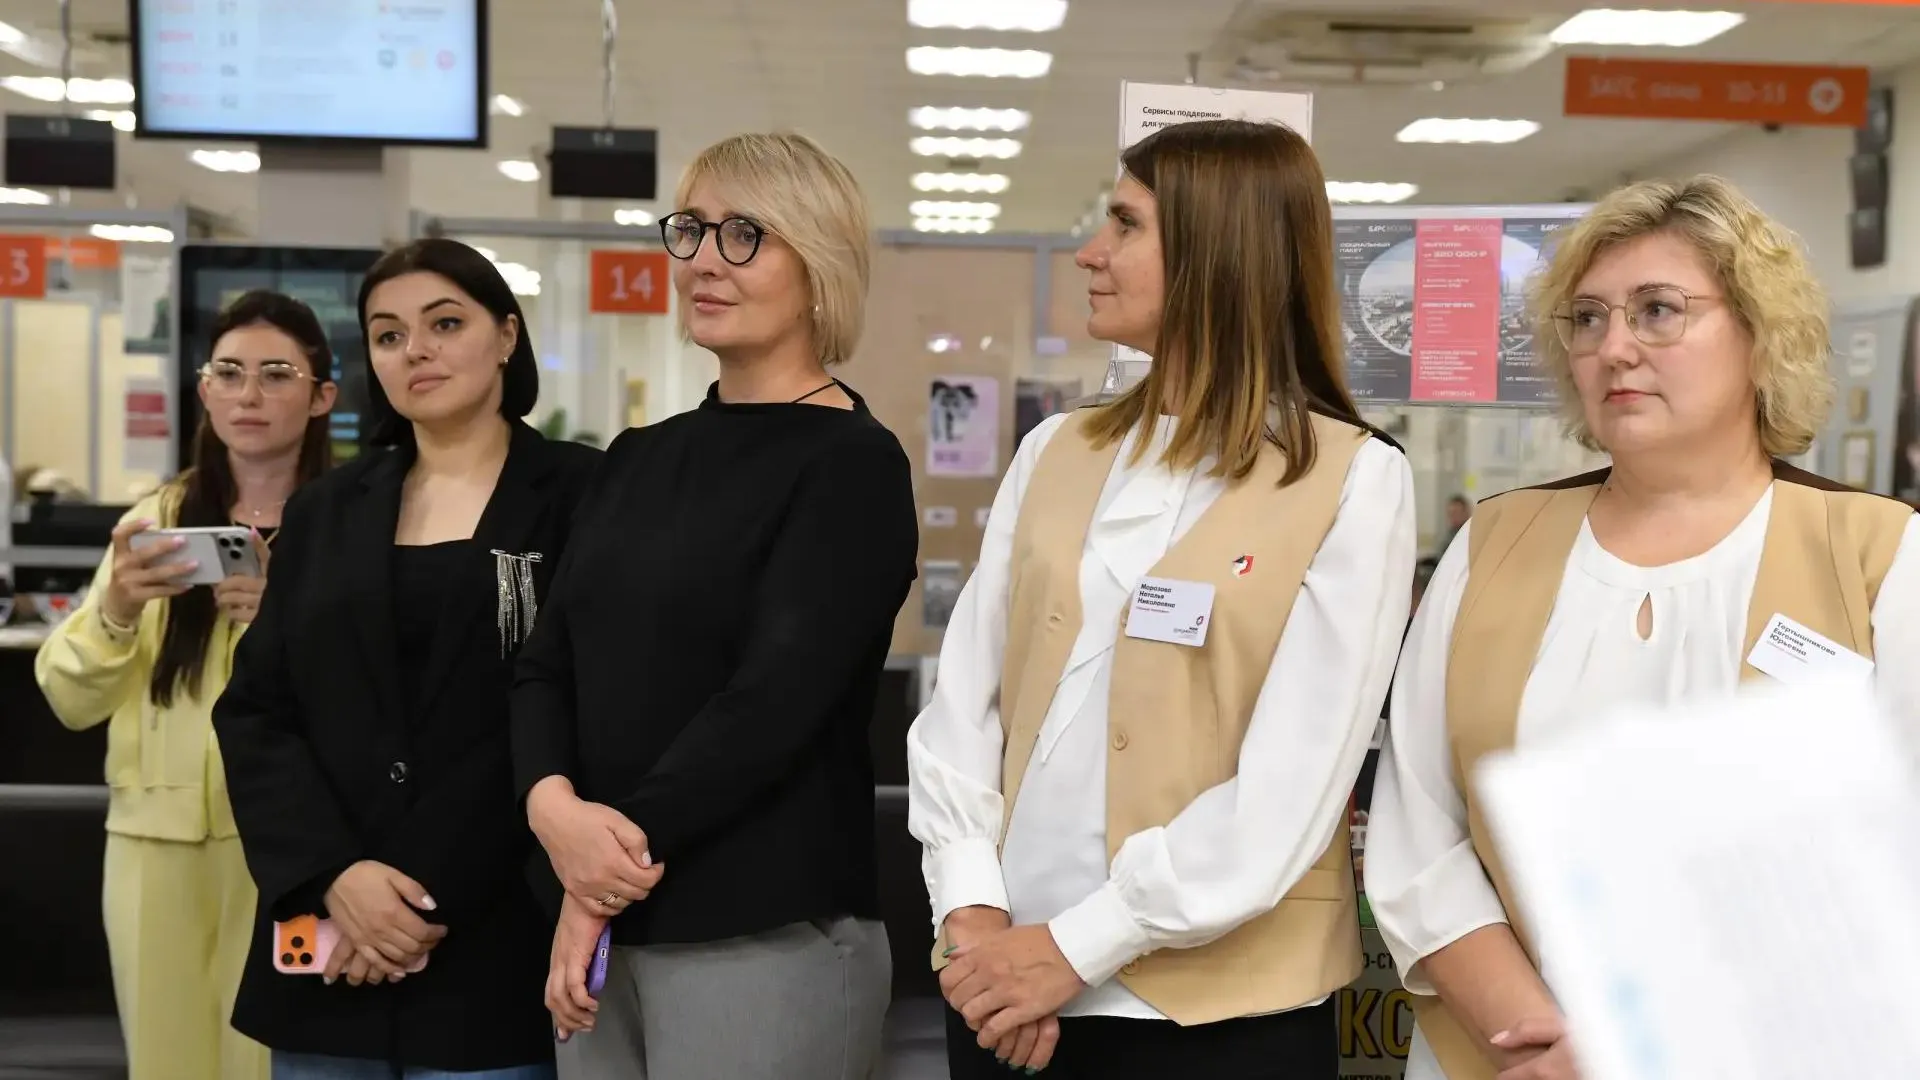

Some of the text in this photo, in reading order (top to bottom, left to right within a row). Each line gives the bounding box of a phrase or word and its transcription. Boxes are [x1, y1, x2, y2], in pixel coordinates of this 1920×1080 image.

[1142, 106, 1221, 119] Сервисы поддержки
[1142, 120, 1157, 128] для
[0, 247, 31, 287] 3
[609, 264, 655, 303] 14
